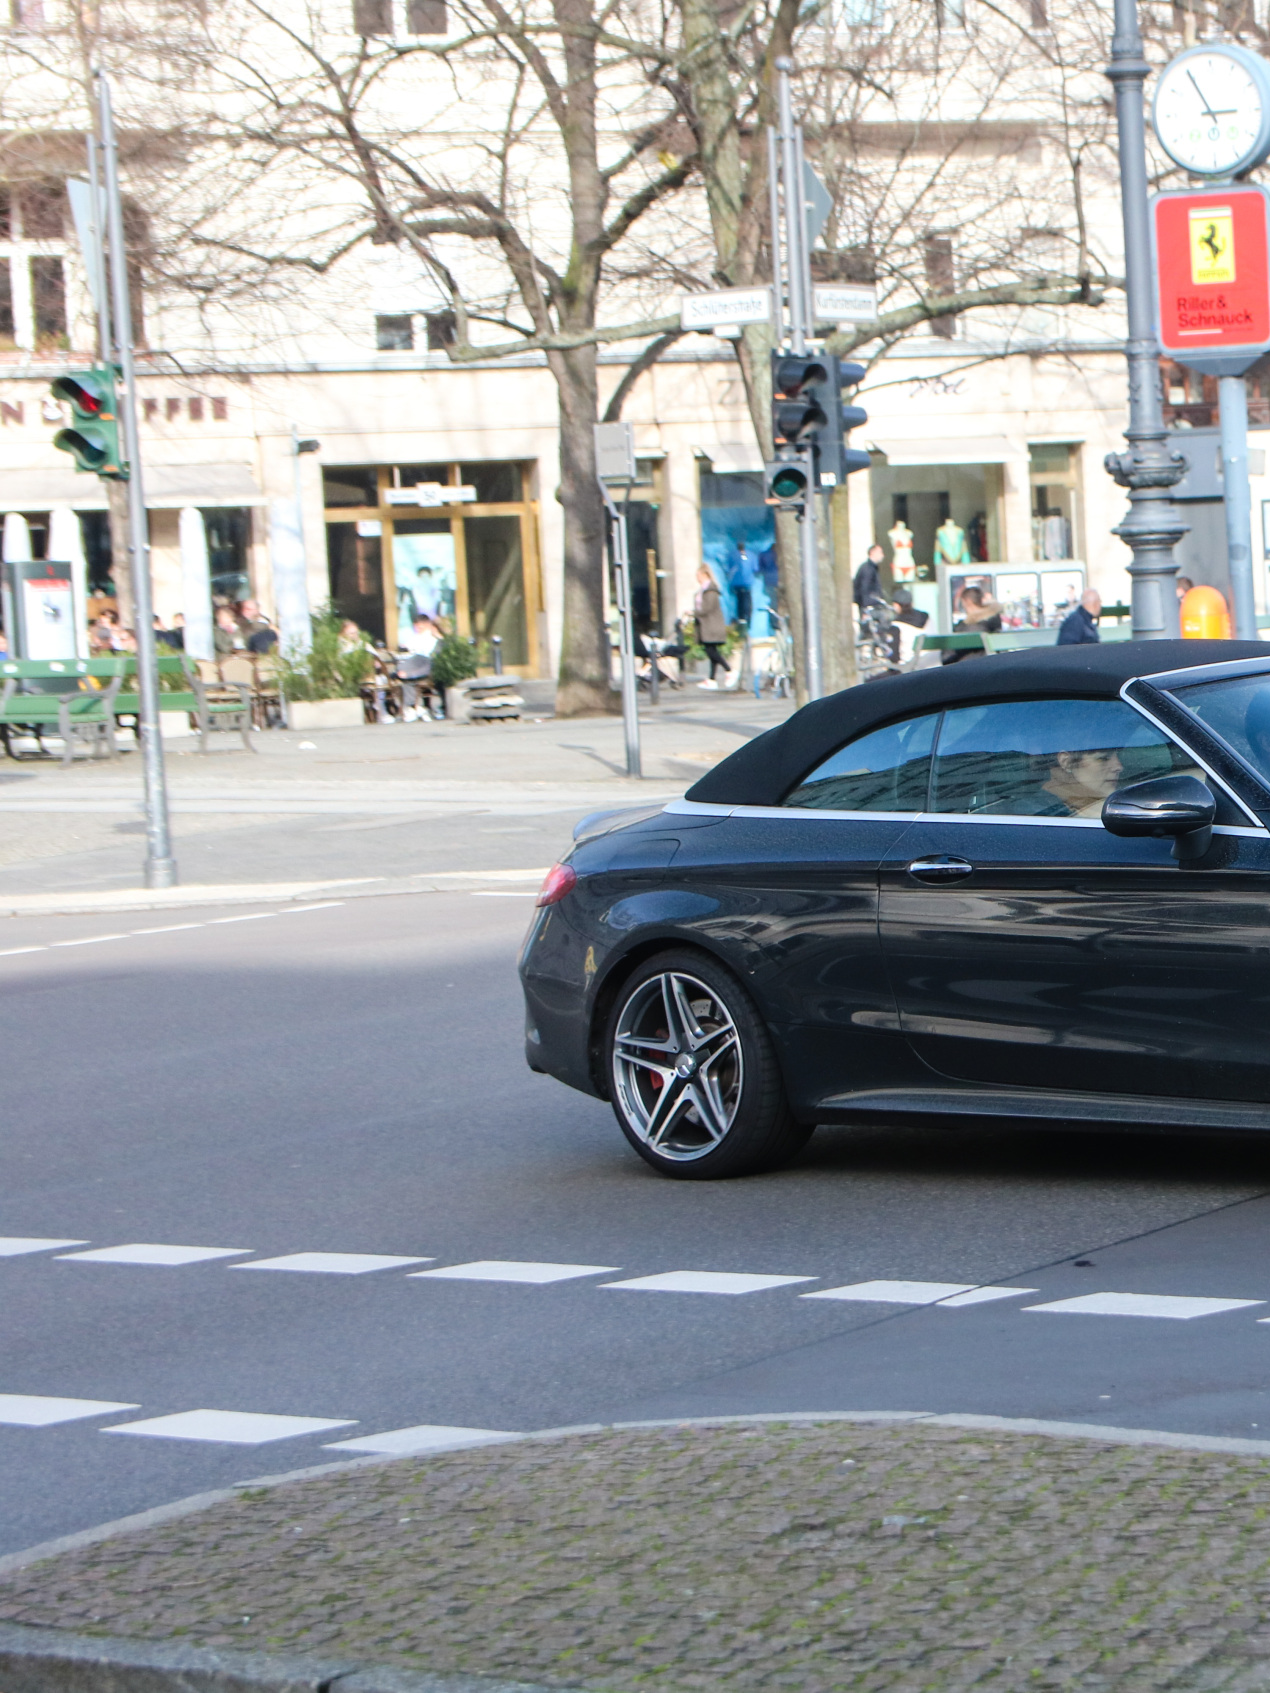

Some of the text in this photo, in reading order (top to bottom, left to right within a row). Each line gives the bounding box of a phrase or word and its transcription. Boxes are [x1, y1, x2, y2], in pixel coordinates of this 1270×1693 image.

[1177, 294, 1227, 312] Riller &
[1178, 309, 1253, 328] Schnauck
